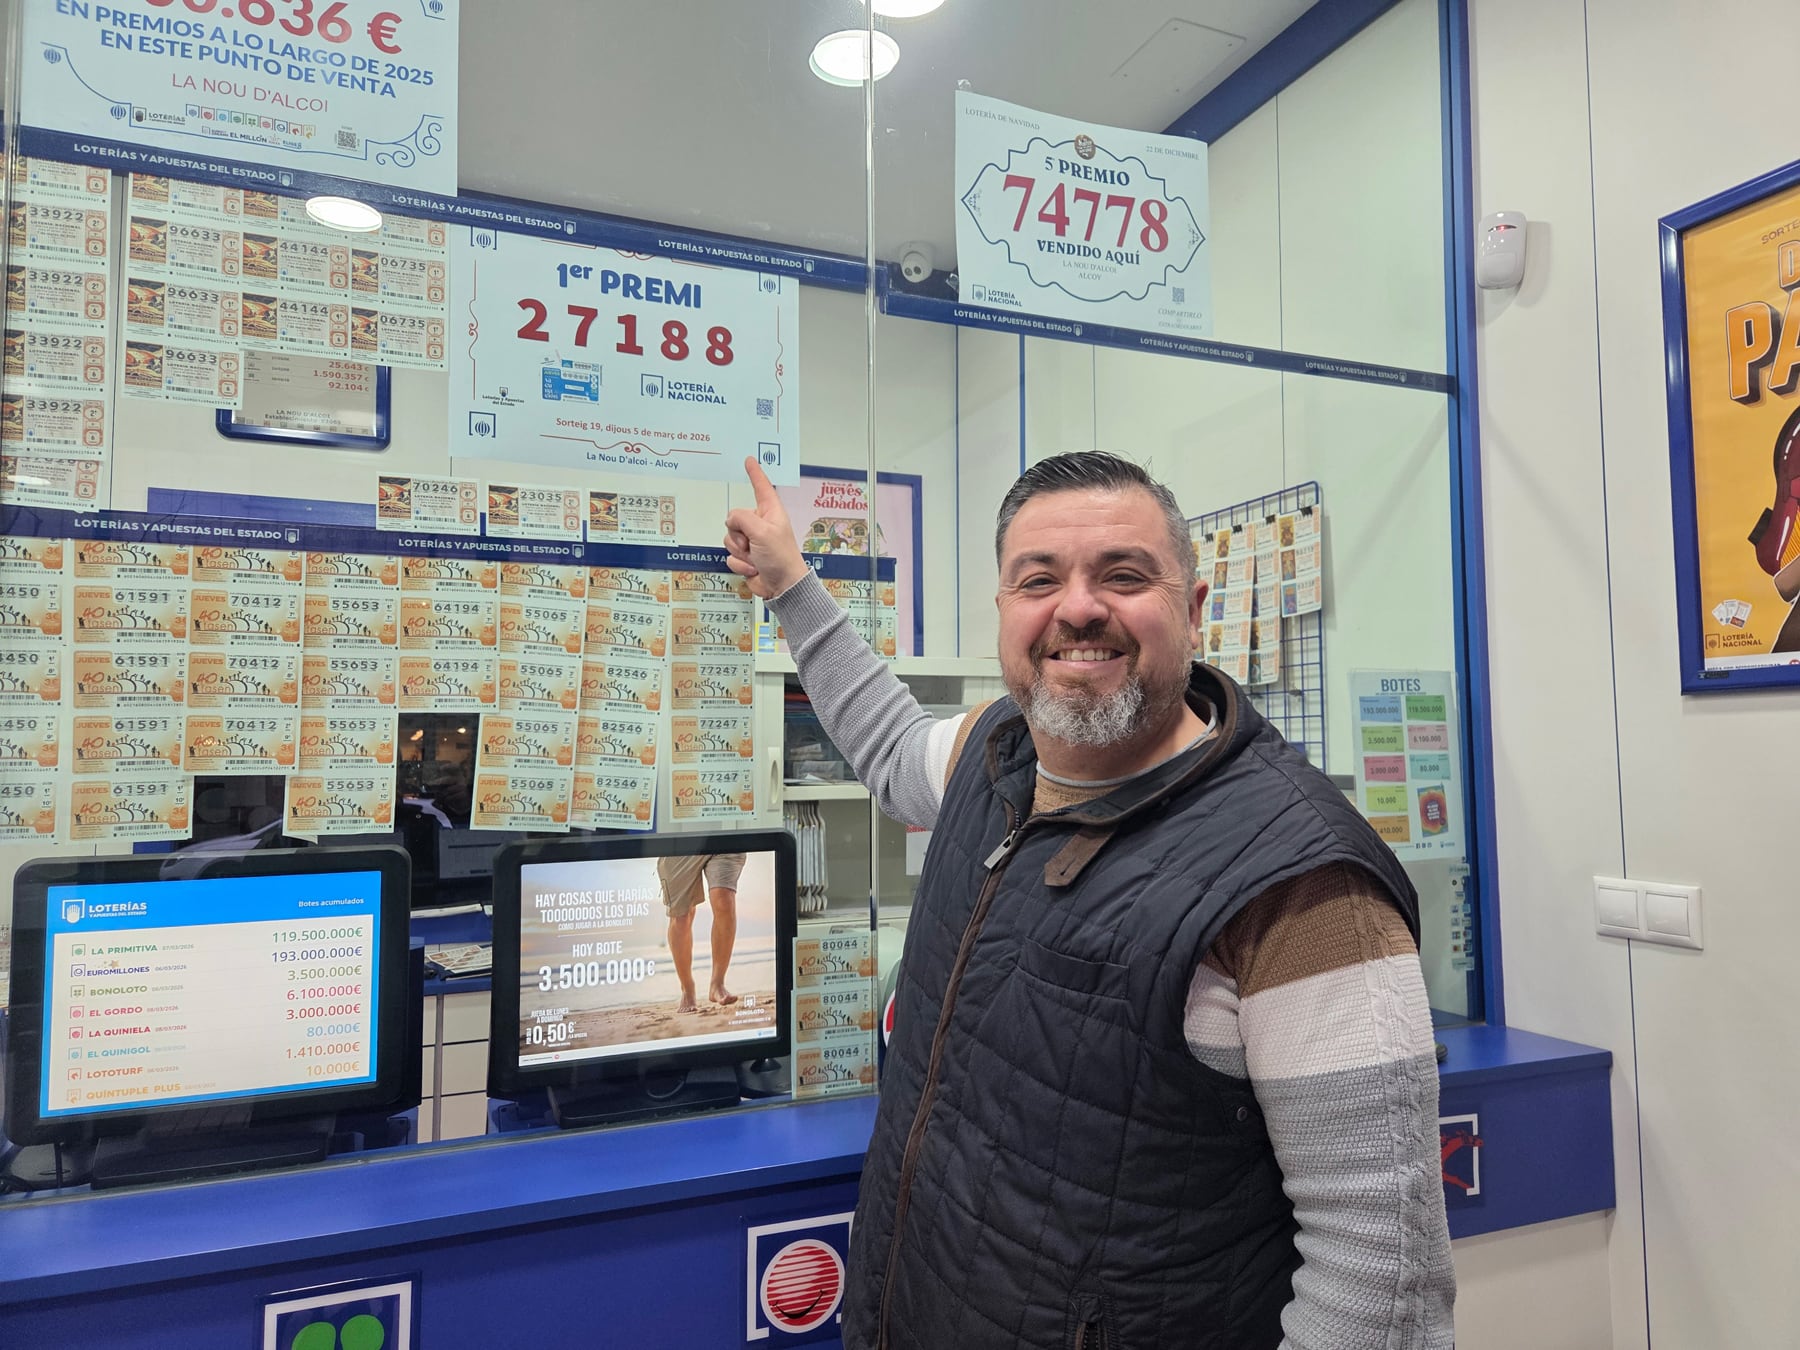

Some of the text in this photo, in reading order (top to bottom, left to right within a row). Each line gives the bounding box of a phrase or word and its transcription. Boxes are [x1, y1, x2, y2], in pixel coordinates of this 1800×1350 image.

[367, 12, 402, 54] €
[56, 0, 434, 86] EN PREMIOS A LO LARGO DE 2025
[101, 29, 396, 98] EN ESTE PUNTO DE VENTA
[172, 73, 328, 112] LA NOU D'ALCOI
[964, 107, 1040, 130] LOTERÍA DE NAVIDAD
[1154, 146, 1163, 155] DE
[1164, 147, 1200, 161] DICIEMBRE
[73, 143, 276, 181] LOTERÍAS Y APUESTAS DEL ESTADO
[1058, 158, 1130, 186] PREMIO
[29, 206, 84, 222] 33922
[392, 194, 562, 230] LOTERÍAS Y APUESTAS DEL ESTADO
[1003, 174, 1169, 253] 74778
[168, 225, 221, 242] 96633
[279, 241, 329, 256] 44144
[658, 240, 704, 253] LOTERÍAS
[712, 248, 753, 261] APUESTAS
[754, 255, 770, 264] DEL
[770, 257, 802, 268] ESTADO
[1036, 239, 1140, 267] VENDIDO AQUÍ
[380, 257, 426, 271] 06735
[1062, 260, 1117, 273] LA NOU D'ALCOI
[28, 270, 83, 286] 33922
[1078, 272, 1102, 281] ALCOY
[557, 263, 701, 308] 1er PREMI
[167, 287, 219, 302] 96633
[988, 289, 1015, 299] LOTERÍA
[279, 301, 329, 315] 44144
[988, 296, 1022, 307] NACIONAL
[953, 309, 991, 321] LOTERÍAS
[997, 316, 1032, 327] APUESTAS
[1032, 321, 1045, 329] DEL
[1046, 322, 1072, 333] ESTADO
[517, 298, 734, 366] 27188
[668, 381, 715, 394] LOTERÍA
[668, 391, 727, 405] NACIONAL
[556, 418, 711, 442] Sorteig 19, dijous 5 de març de 2026
[586, 452, 596, 461] La
[599, 453, 616, 463] Nou
[619, 455, 648, 466] D'alcoi
[655, 460, 678, 470] Alcoy
[413, 482, 458, 494] 70246
[820, 482, 862, 499] jueves
[520, 490, 562, 501] 23035
[620, 497, 660, 508] 22423
[74, 518, 282, 540] LOTERÍAS Y APUESTAS DEL ESTADO
[115, 591, 169, 602] 61591
[231, 595, 281, 607] 70412
[332, 599, 380, 610] 55653
[434, 603, 480, 613] 64194
[525, 608, 567, 621] 55065
[612, 612, 653, 625] 82546
[701, 613, 739, 623] 77247
[1722, 633, 1753, 641] LOTERÍA
[1722, 639, 1762, 648] NACIONAL
[1381, 678, 1421, 692] BOTES
[114, 719, 168, 730] 61591
[226, 720, 277, 730] 70412
[327, 780, 374, 791] 55653
[320, 898, 364, 906] acumulados
[535, 886, 654, 908] HAY COSAS QUE HARÍAS
[88, 901, 147, 913] LOTERÍAS
[604, 904, 624, 918] LOS
[626, 901, 649, 917] DÍAS
[272, 927, 363, 943] 119.500.000€
[91, 947, 104, 955] LA
[107, 945, 157, 954] PRIMITIVA
[572, 940, 623, 958] HOY BOTE
[822, 940, 858, 950] 80044
[271, 946, 363, 963] 193.000.000€
[86, 966, 150, 977] EUROMILLONES
[287, 965, 362, 981] 3.500.000€
[90, 985, 148, 997] BONOLOTO
[287, 984, 362, 1000] 6.100.000€
[89, 1006, 143, 1017] EL GORDO
[286, 1003, 361, 1020] 3.000.000€
[88, 1030, 101, 1038] LA
[104, 1026, 151, 1037] QUINIELA
[306, 1022, 361, 1037] 80.000€
[87, 1046, 151, 1059] EL QUINIGOL
[286, 1041, 361, 1059] 1.410.000€
[87, 1067, 143, 1079] LOTOTURF
[306, 1061, 360, 1077] 10.000€
[154, 1083, 181, 1093] PLUS
